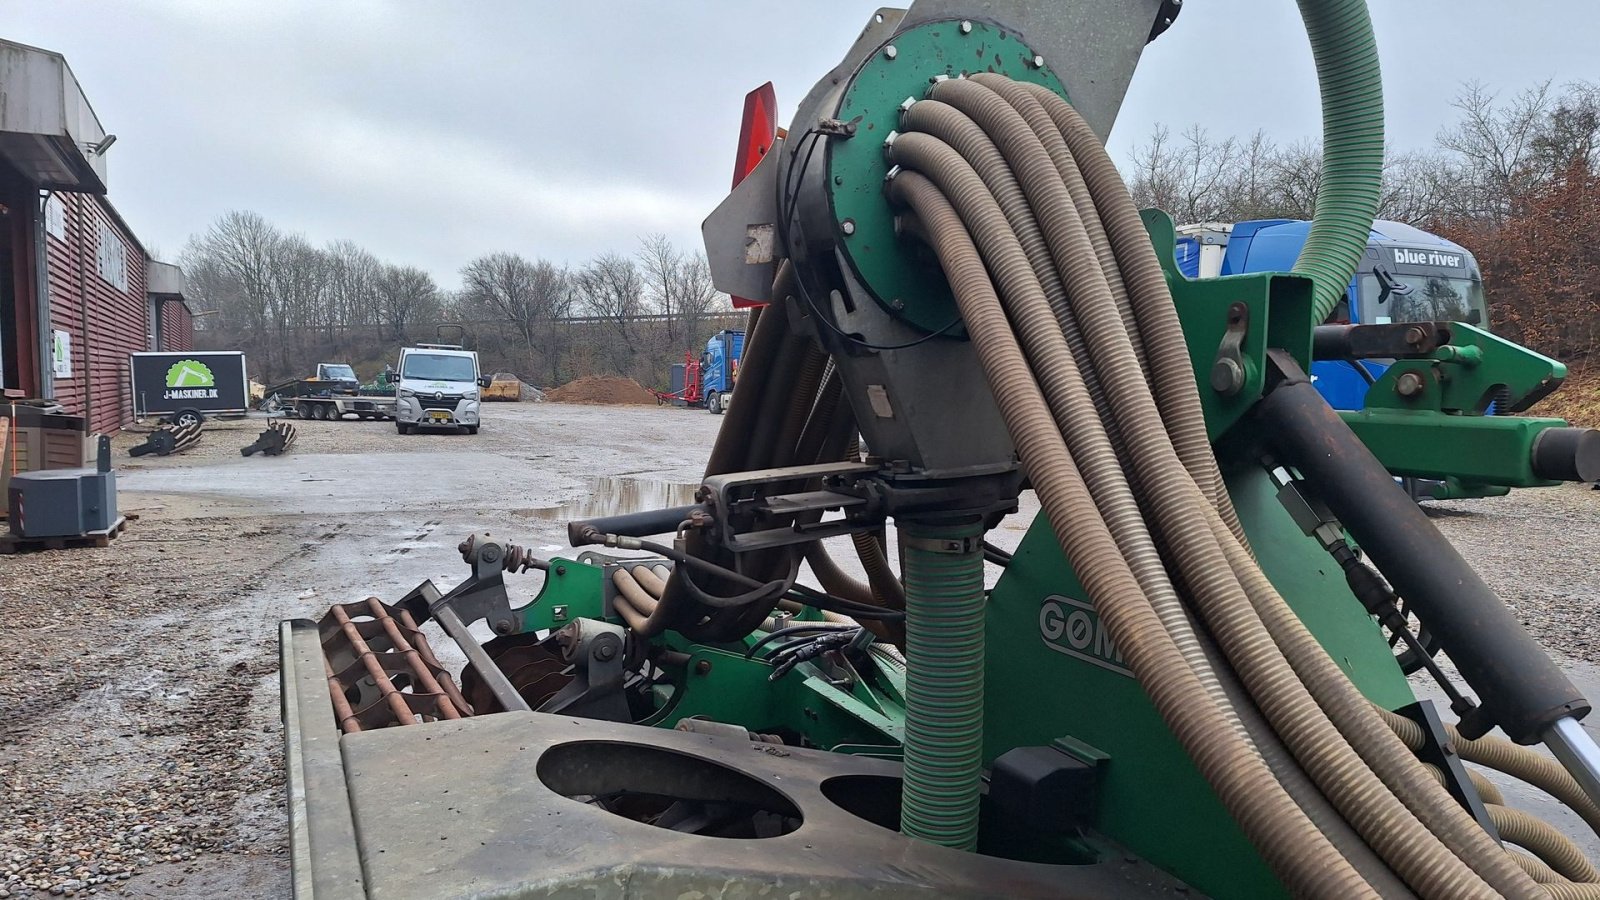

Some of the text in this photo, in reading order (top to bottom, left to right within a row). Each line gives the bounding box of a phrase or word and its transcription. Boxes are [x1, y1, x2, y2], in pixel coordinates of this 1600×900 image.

[1394, 248, 1460, 267] blue river
[163, 389, 218, 399] J-MASKINER.DK
[1039, 602, 1127, 665] GØM
